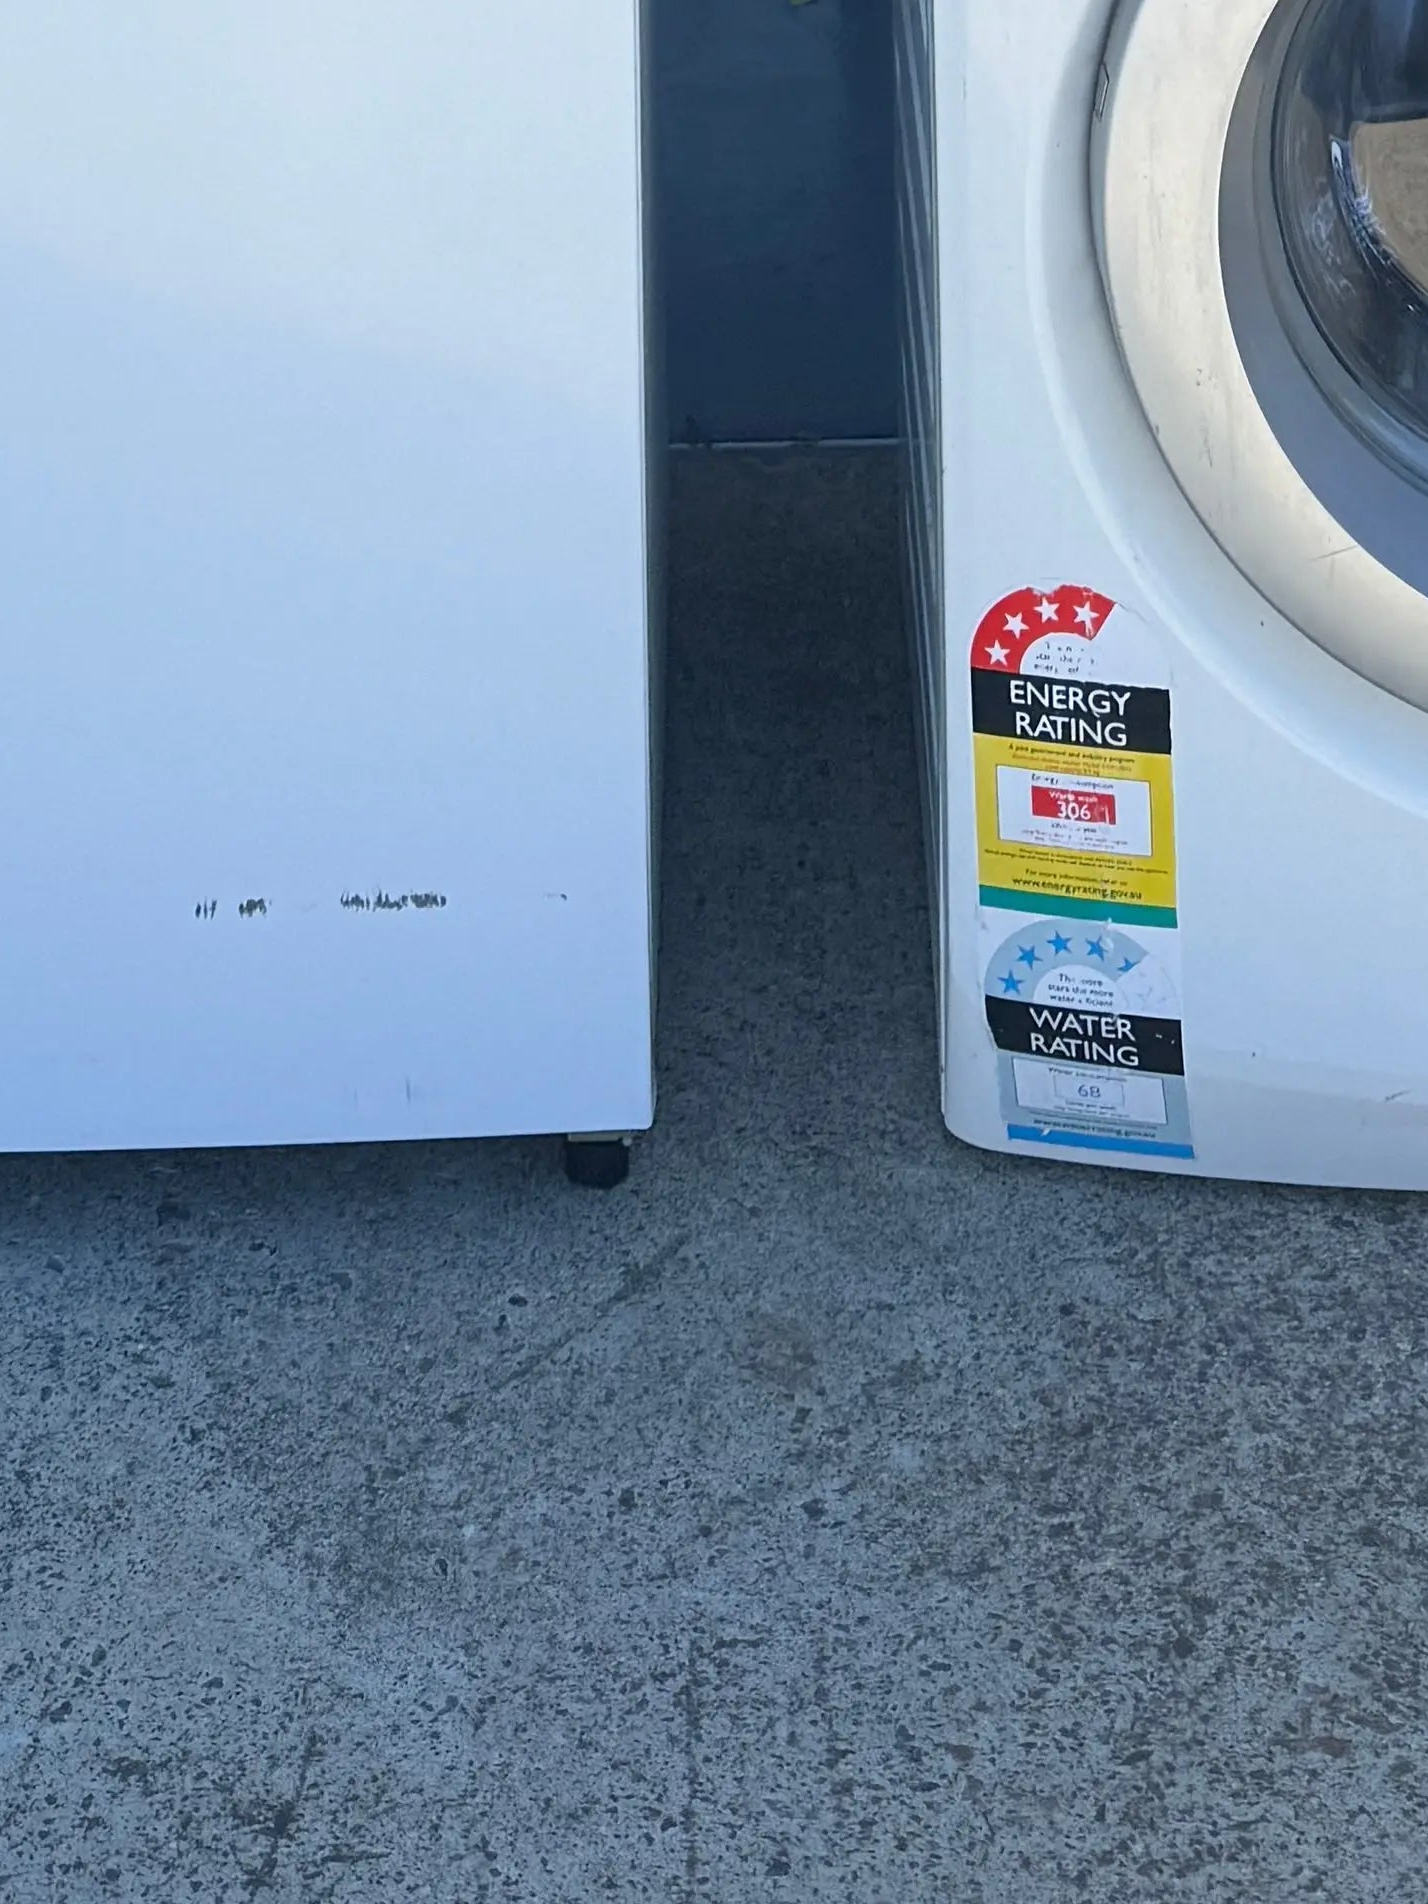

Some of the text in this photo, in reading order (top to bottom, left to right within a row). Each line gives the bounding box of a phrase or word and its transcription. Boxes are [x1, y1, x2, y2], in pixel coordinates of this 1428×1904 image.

[1010, 679, 1131, 716] ENERGY
[1015, 711, 1127, 746] RATING
[1057, 800, 1091, 820] 306
[1029, 1007, 1136, 1041] WATER
[1030, 1033, 1139, 1066] RATING
